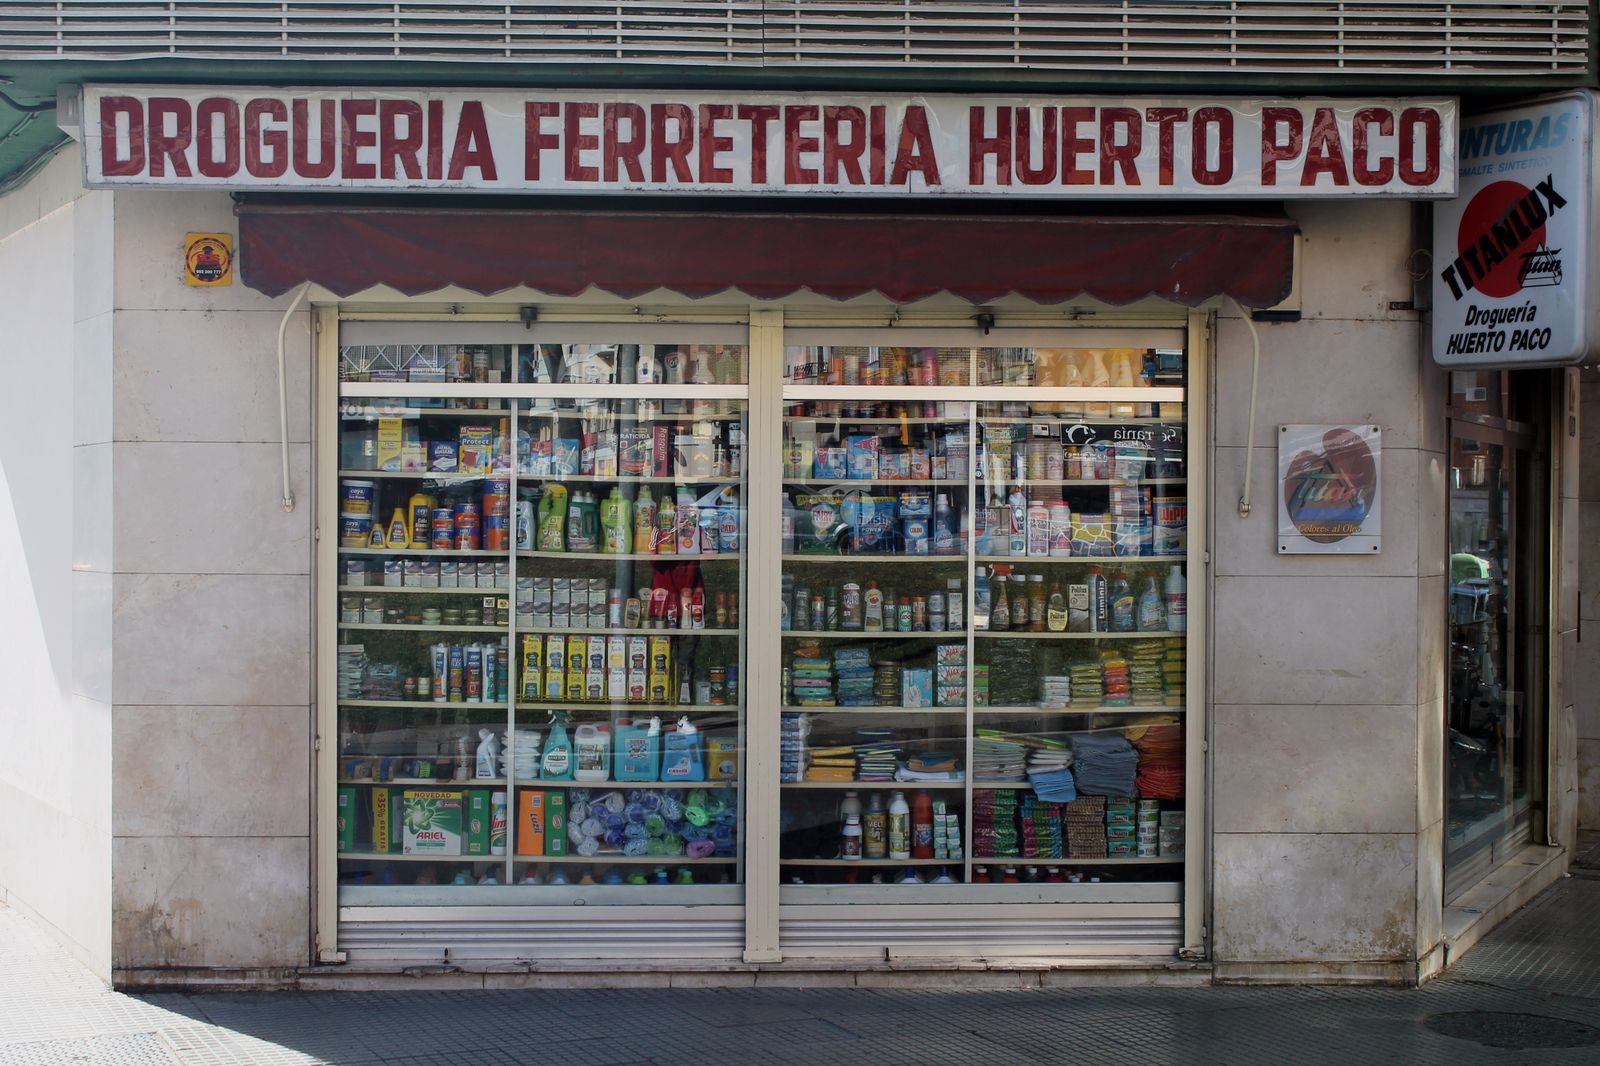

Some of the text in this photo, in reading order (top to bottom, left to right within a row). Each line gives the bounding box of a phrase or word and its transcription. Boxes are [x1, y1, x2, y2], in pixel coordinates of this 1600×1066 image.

[101, 96, 1441, 186] DROGUERIA FERRETERIA HUERTO PACO
[1459, 112, 1571, 161] INTURAS
[1459, 164, 1493, 177] SMALTE
[1441, 174, 1567, 300] TITANLUX
[1465, 300, 1537, 329] Droguería
[1446, 327, 1552, 354] HUERTO PACO
[462, 438, 490, 446] Protect
[659, 427, 668, 461] Rasquim
[856, 512, 887, 525] finish
[1298, 524, 1329, 533] Colores
[1331, 524, 1341, 533] al
[416, 831, 447, 840] ARIEL
